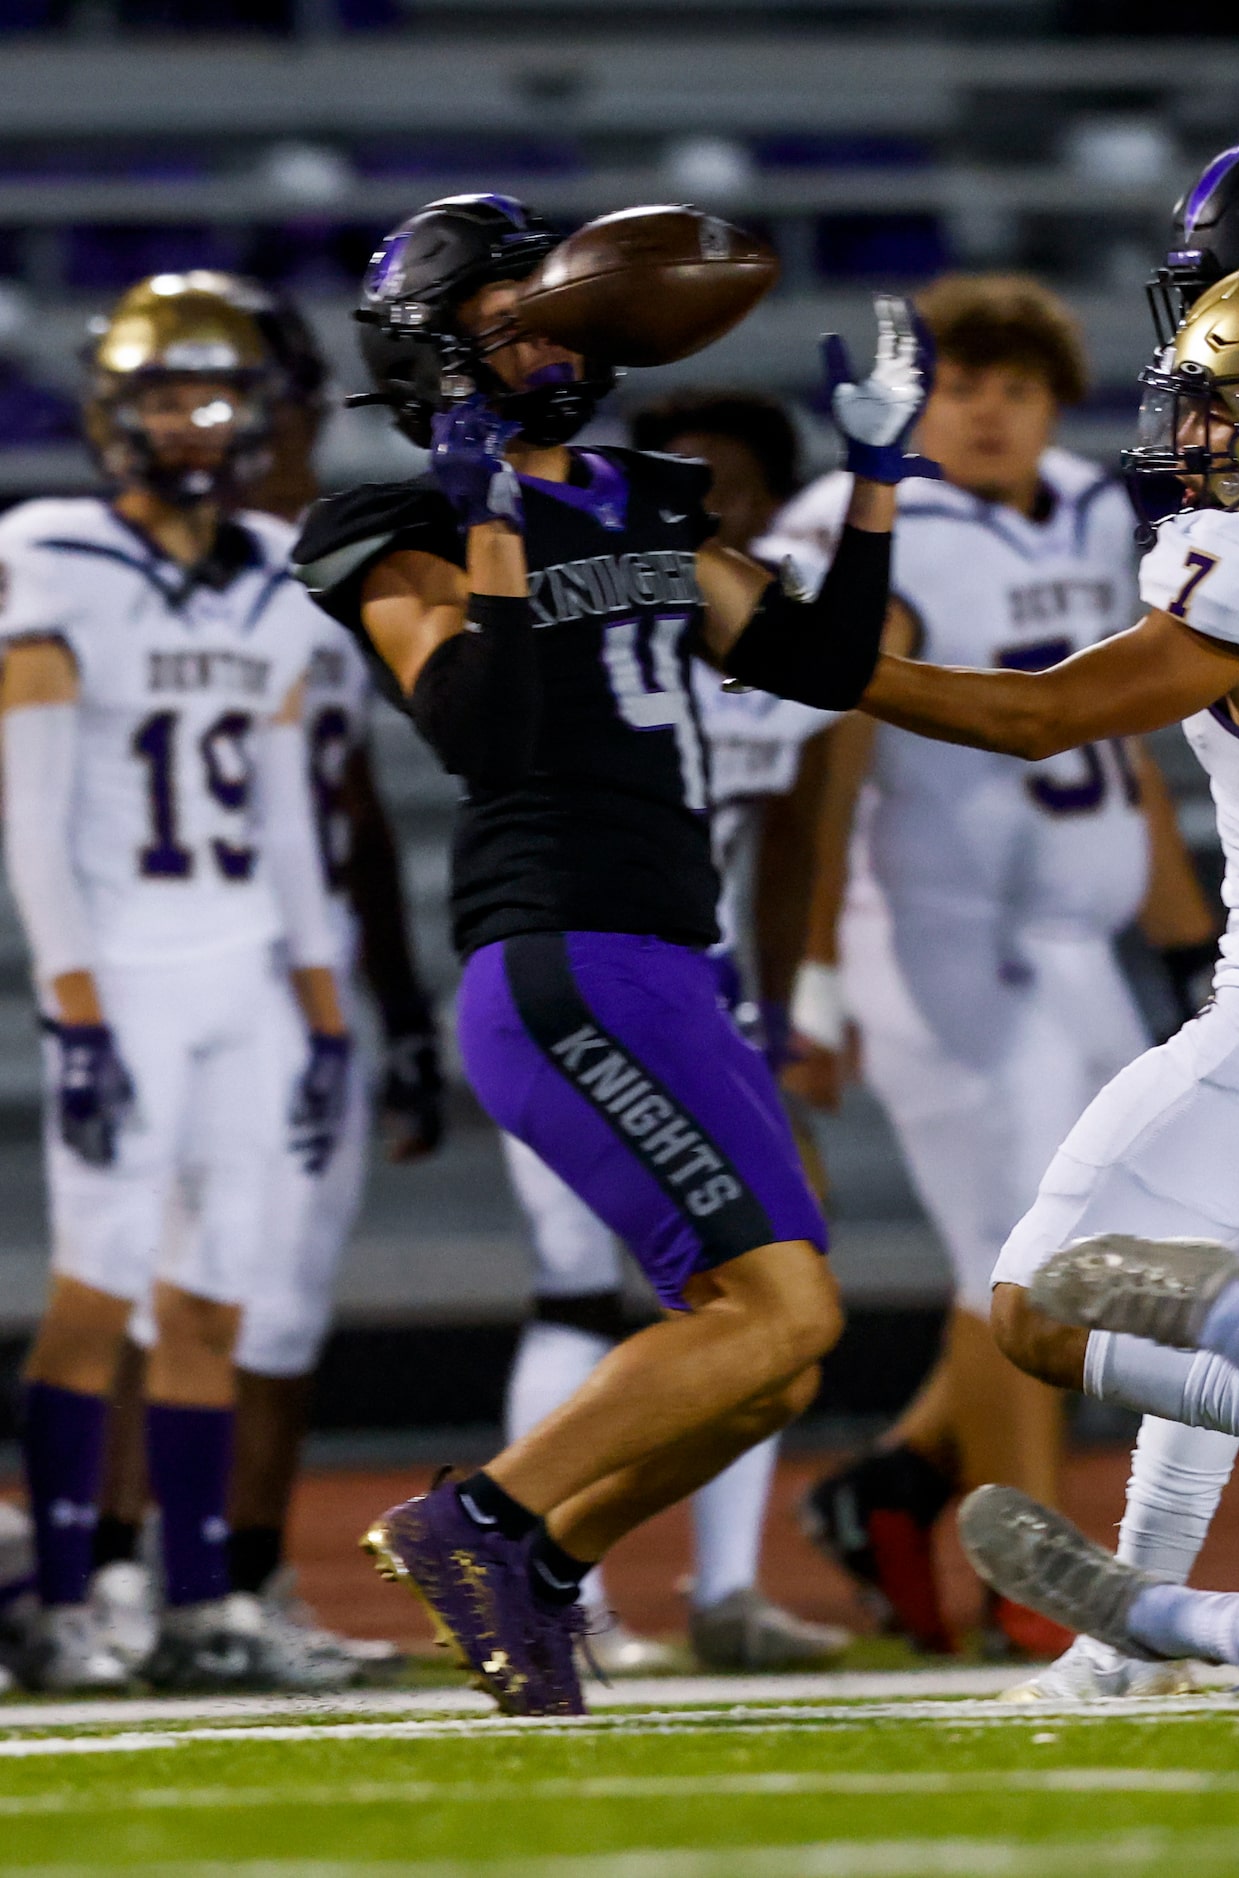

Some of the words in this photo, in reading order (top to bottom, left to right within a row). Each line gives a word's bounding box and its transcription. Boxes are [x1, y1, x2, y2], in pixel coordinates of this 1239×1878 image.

[1167, 546, 1222, 622] 7
[130, 706, 264, 882] 19
[600, 612, 706, 816] 4
[550, 1022, 743, 1218] KNIGHTS
